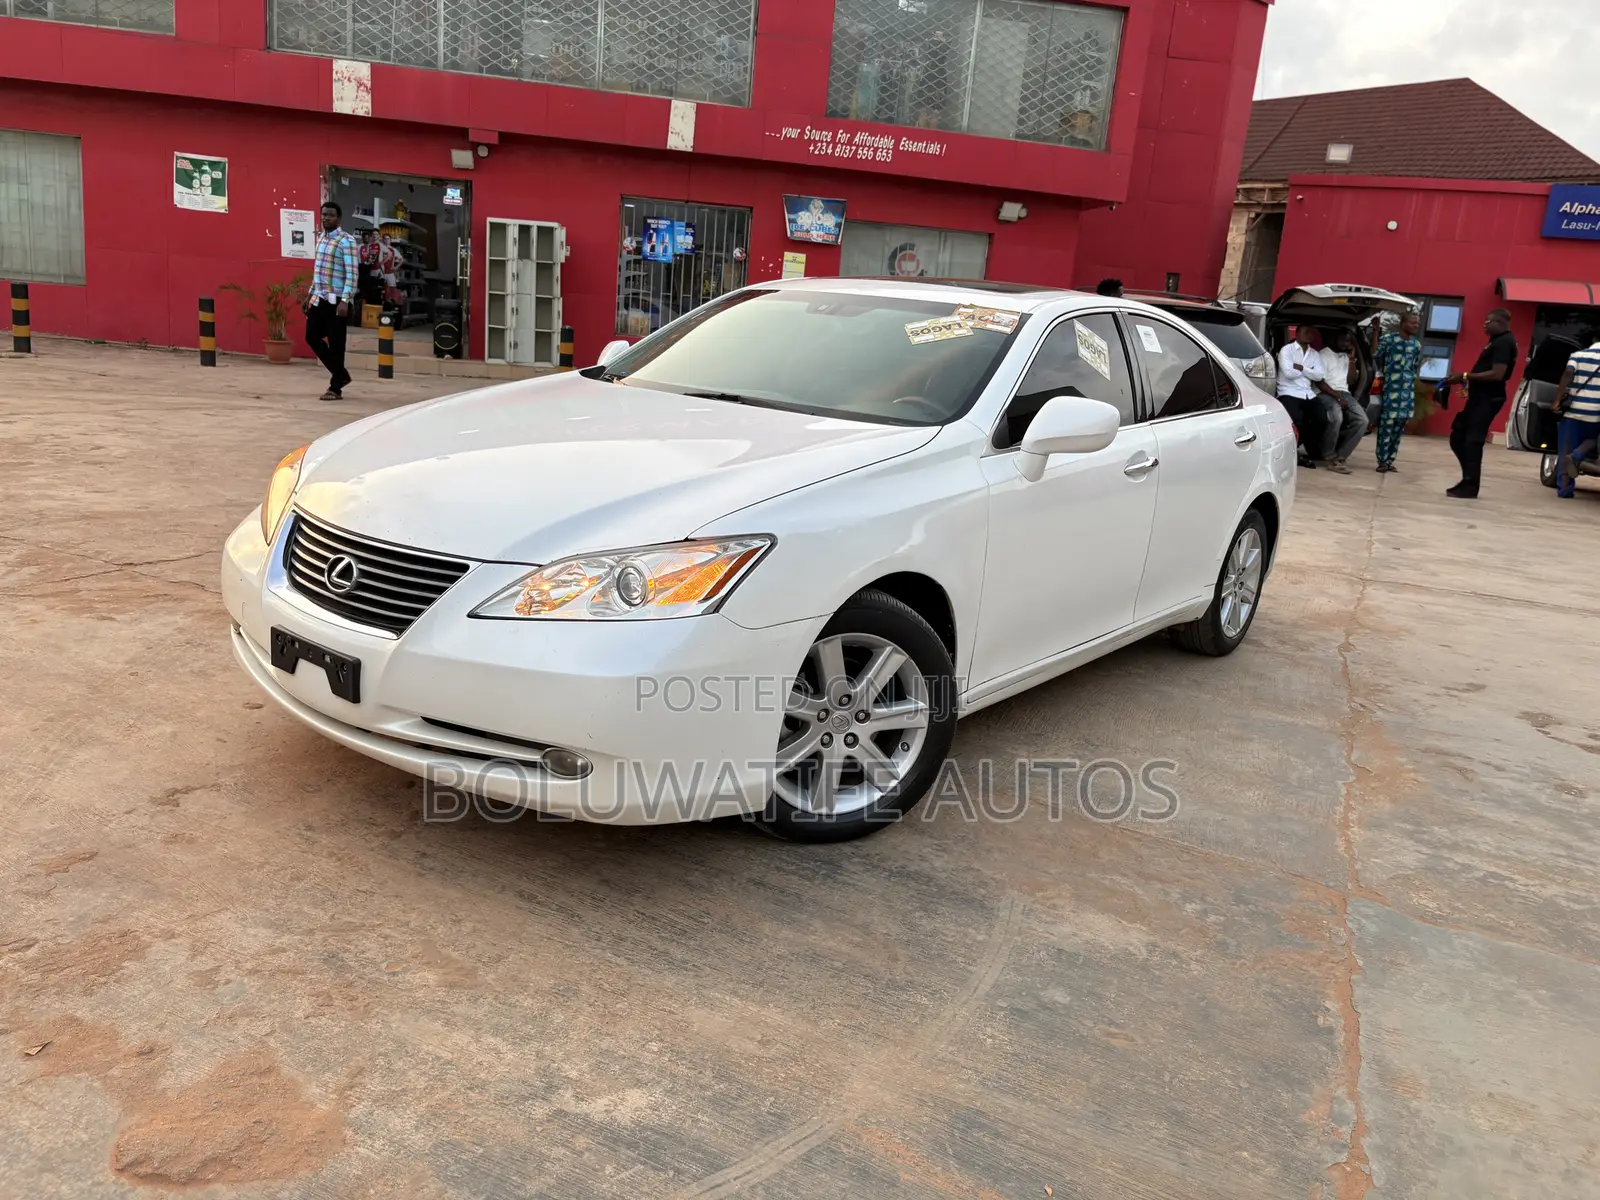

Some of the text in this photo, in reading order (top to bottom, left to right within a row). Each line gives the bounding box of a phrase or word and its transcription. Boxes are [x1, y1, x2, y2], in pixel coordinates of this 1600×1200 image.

[804, 125, 832, 142] Source
[836, 129, 851, 143] For
[853, 131, 895, 149] Affordable
[809, 142, 893, 162] +234 8137 556 653
[793, 231, 836, 242] SOLD HERE
[809, 223, 840, 235] CUBES
[910, 322, 963, 337] LAGOS
[1077, 334, 1107, 364] LAGOS
